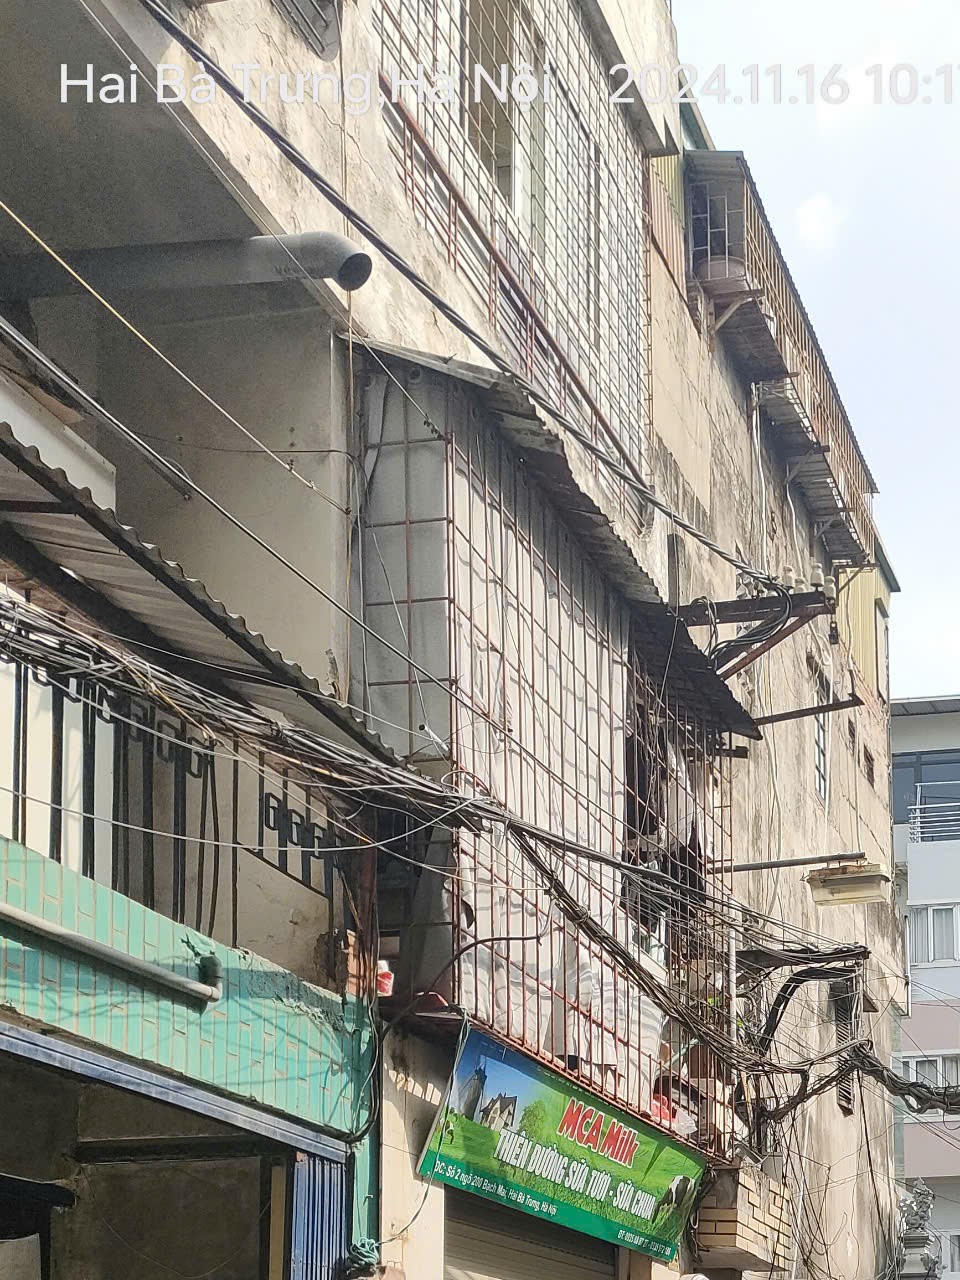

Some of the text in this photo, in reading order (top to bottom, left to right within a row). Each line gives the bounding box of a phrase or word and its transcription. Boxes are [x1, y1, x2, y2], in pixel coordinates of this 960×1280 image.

[556, 1097, 641, 1169] MCA Milk
[454, 1169, 461, 1180] 2
[493, 1128, 533, 1169] THIÊN
[526, 1143, 570, 1186] ĐƯỜNG
[564, 1158, 591, 1194] SỮA
[612, 1179, 636, 1212] SỮA
[631, 1190, 657, 1221] CHUA
